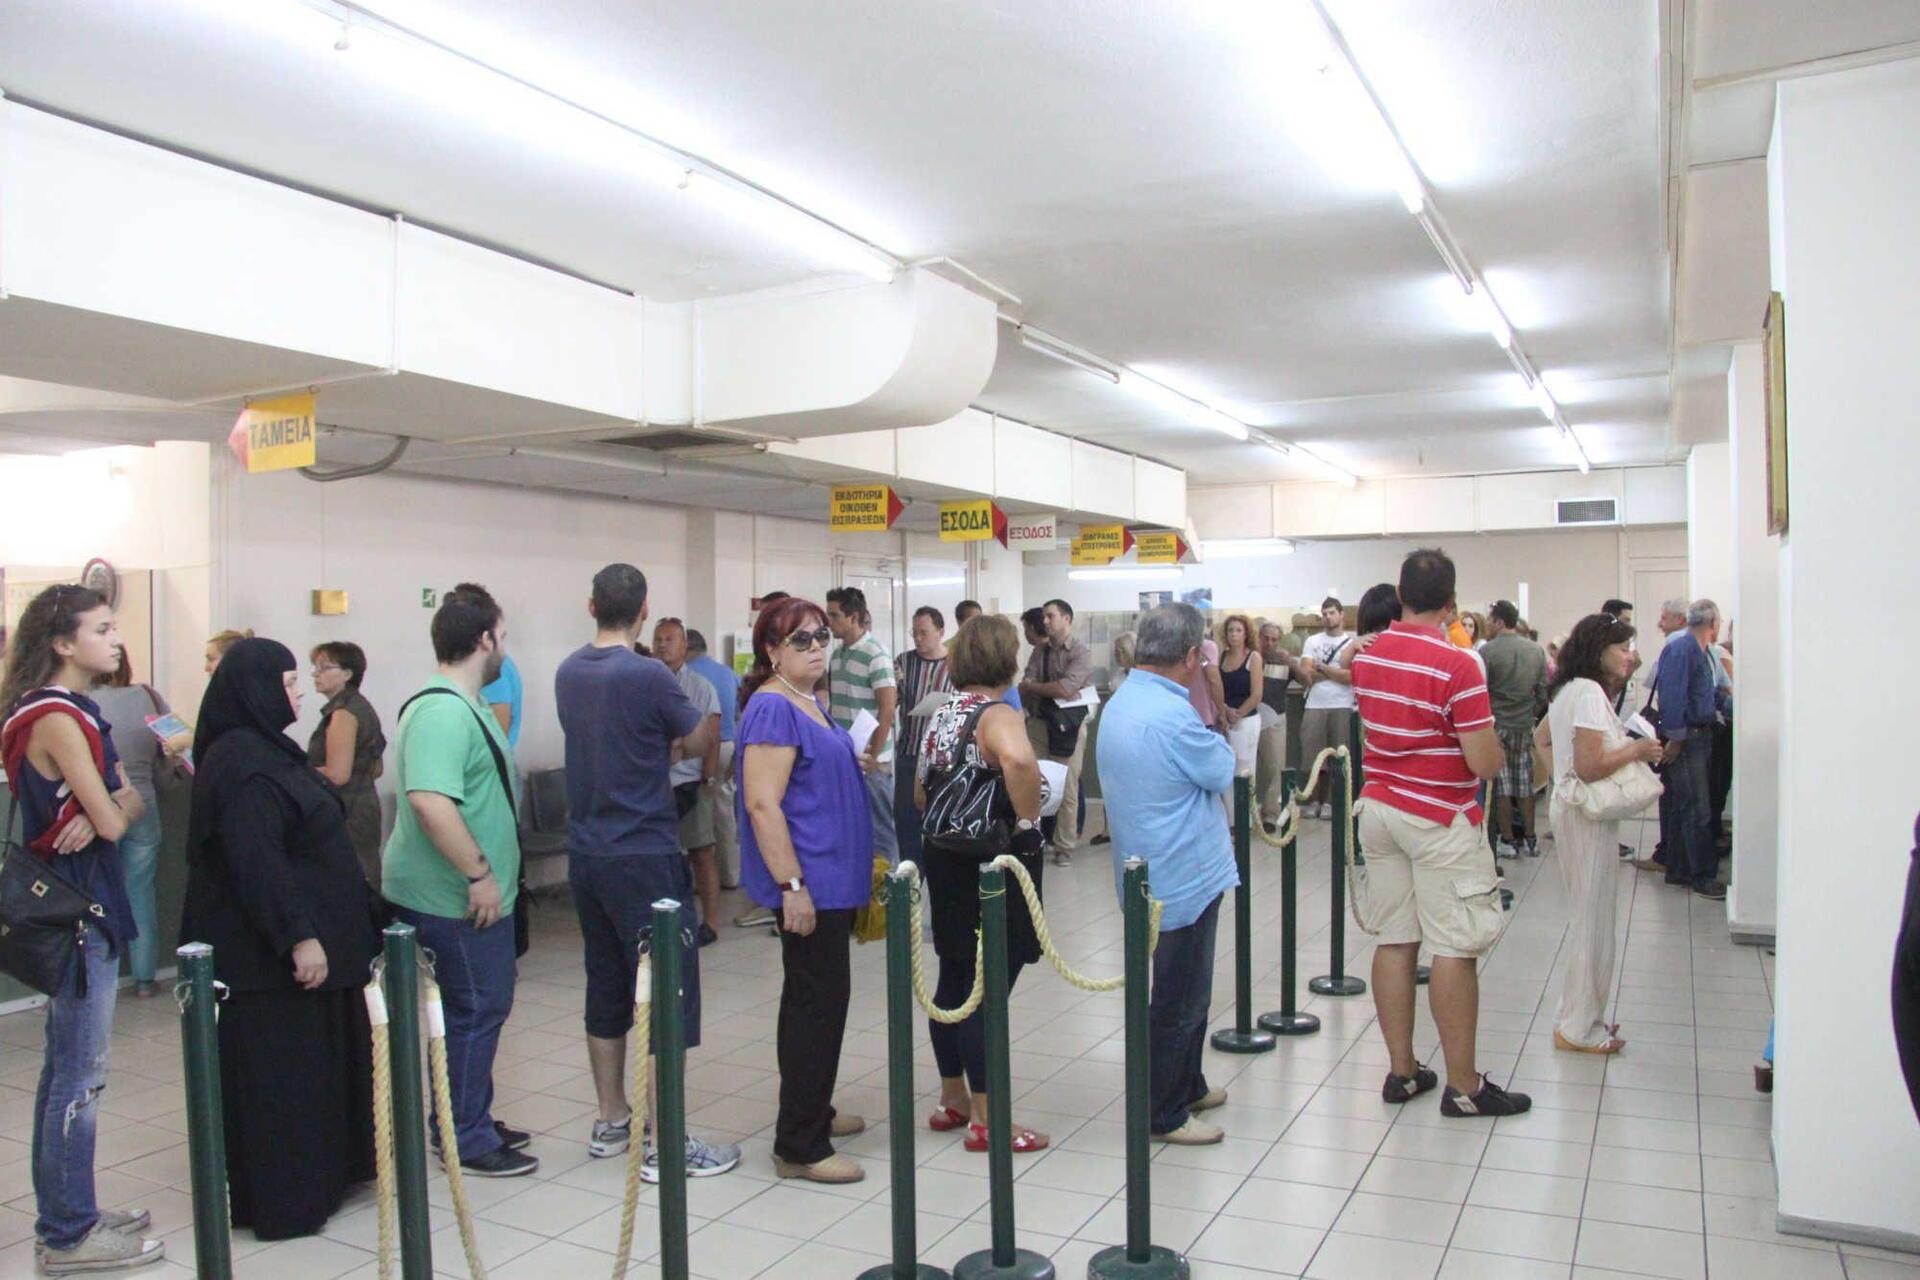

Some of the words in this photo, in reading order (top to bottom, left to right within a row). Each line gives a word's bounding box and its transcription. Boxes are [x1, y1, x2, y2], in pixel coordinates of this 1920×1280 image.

[249, 416, 311, 449] ΤΑΜΕΙΑ
[940, 510, 990, 532] ΕΣΟΔΑ
[1008, 526, 1053, 540] ΕΞΟΔΟΣ
